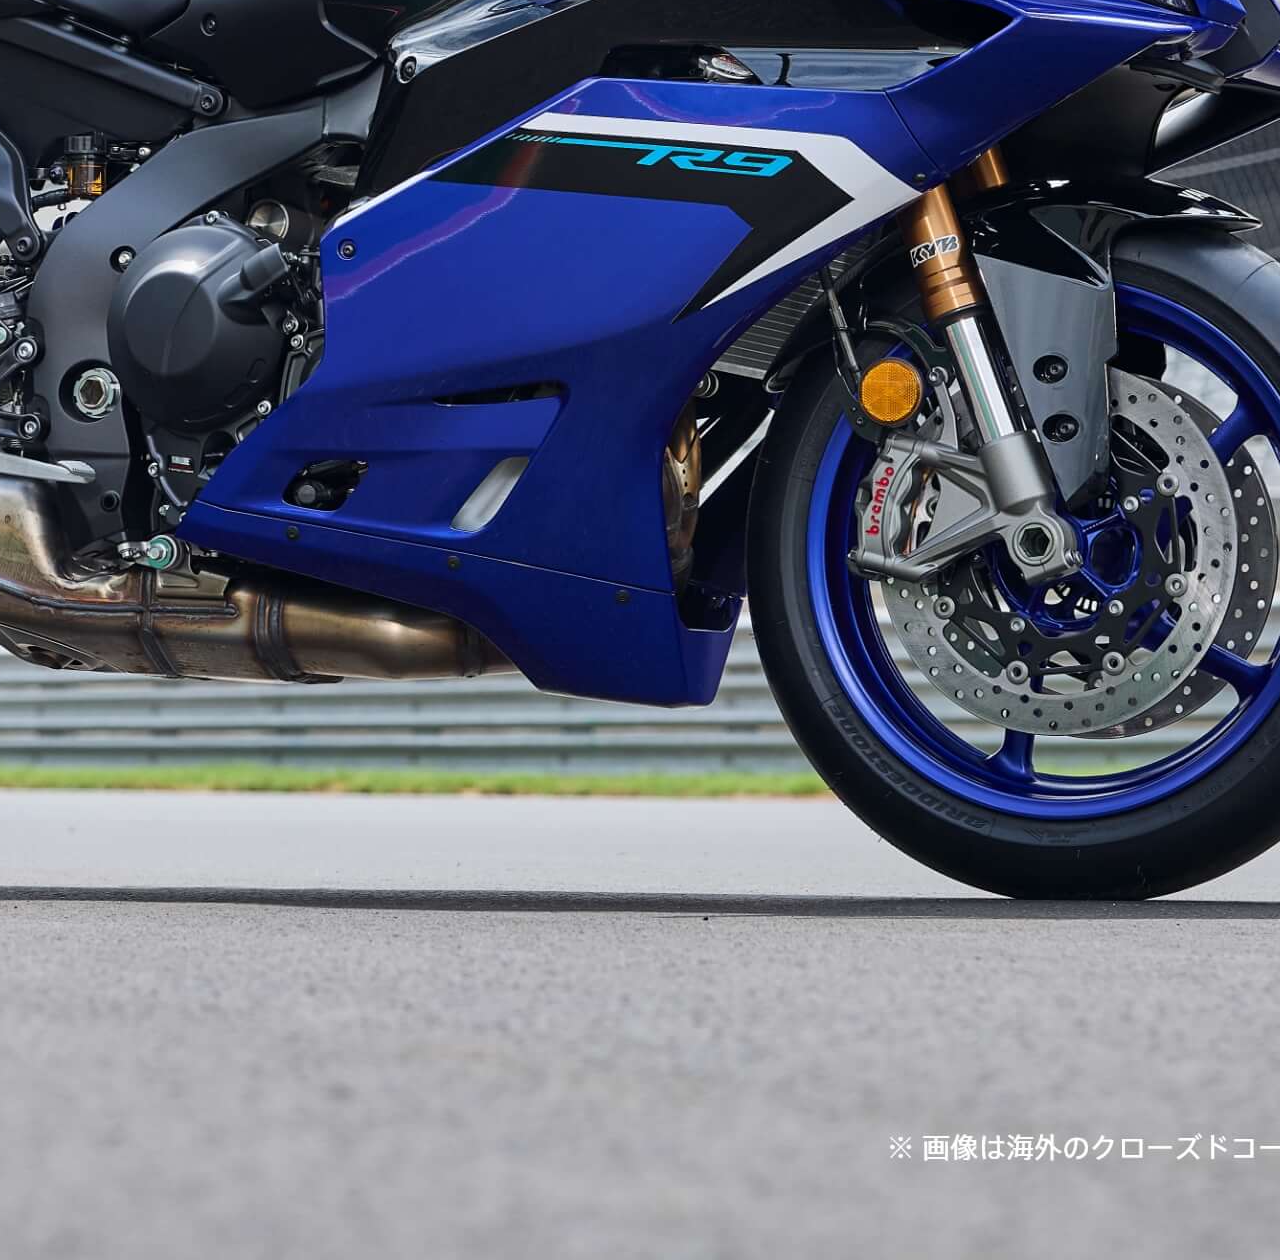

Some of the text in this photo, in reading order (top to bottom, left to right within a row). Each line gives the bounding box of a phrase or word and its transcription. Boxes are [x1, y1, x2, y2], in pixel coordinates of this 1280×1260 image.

[634, 142, 793, 177] R9
[910, 234, 960, 269] KYB
[865, 466, 895, 536] brembo
[826, 700, 991, 829] BRIDGESTONE
